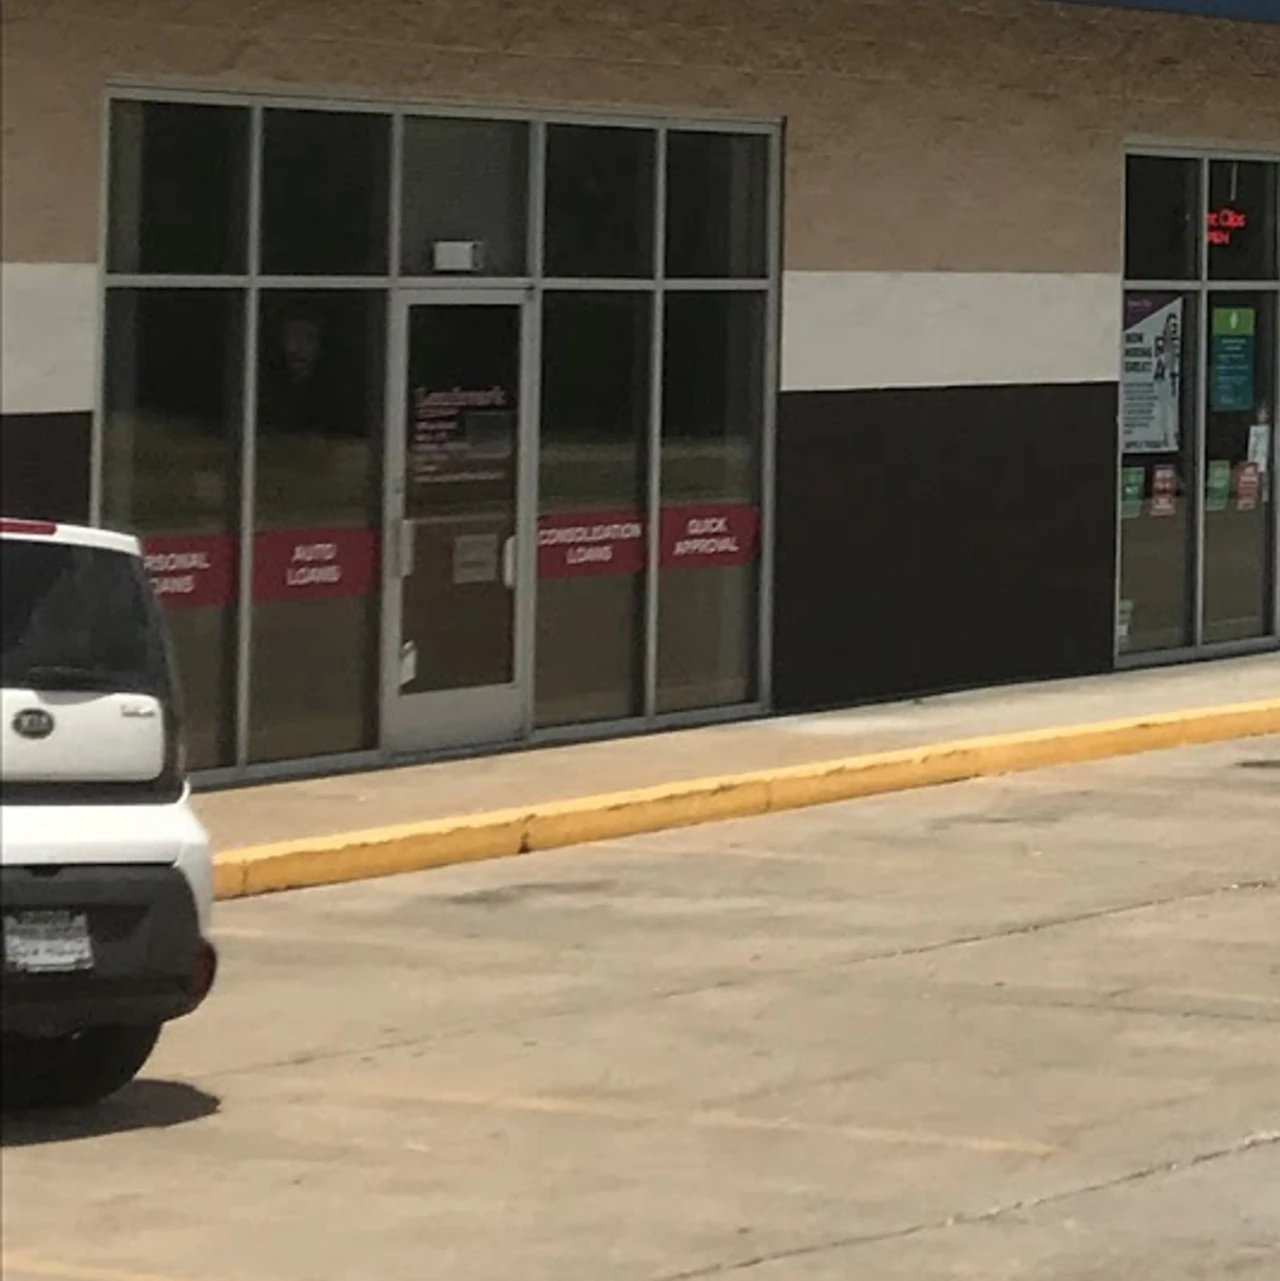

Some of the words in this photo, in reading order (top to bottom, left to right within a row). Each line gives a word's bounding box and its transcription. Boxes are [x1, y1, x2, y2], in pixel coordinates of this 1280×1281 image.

[538, 523, 642, 545] CONSOLIDATION
[687, 518, 728, 534] QUICK
[292, 544, 337, 562] AUTO
[566, 546, 612, 564] LOANS
[673, 536, 739, 556] APPROVAL
[150, 575, 195, 595] OANS
[287, 566, 341, 586] LOANS
